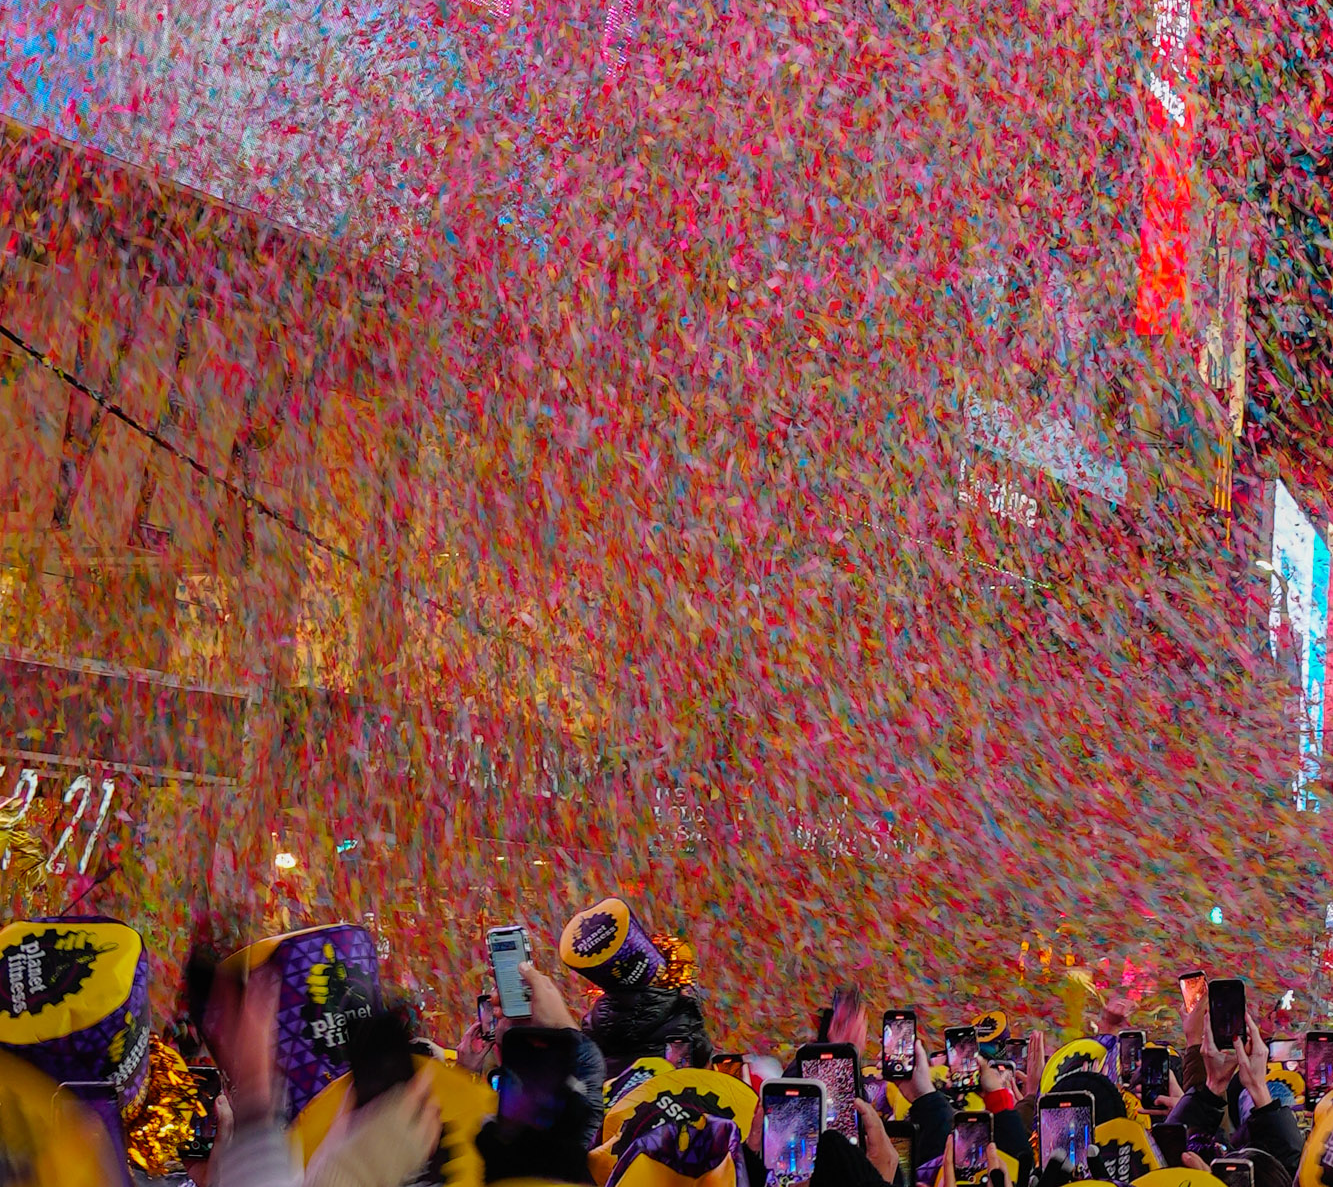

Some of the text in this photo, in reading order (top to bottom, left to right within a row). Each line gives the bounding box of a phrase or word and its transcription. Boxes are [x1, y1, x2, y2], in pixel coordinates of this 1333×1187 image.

[7, 953, 28, 1016] fitness
[20, 939, 47, 996] planet
[309, 1003, 373, 1039] planet
